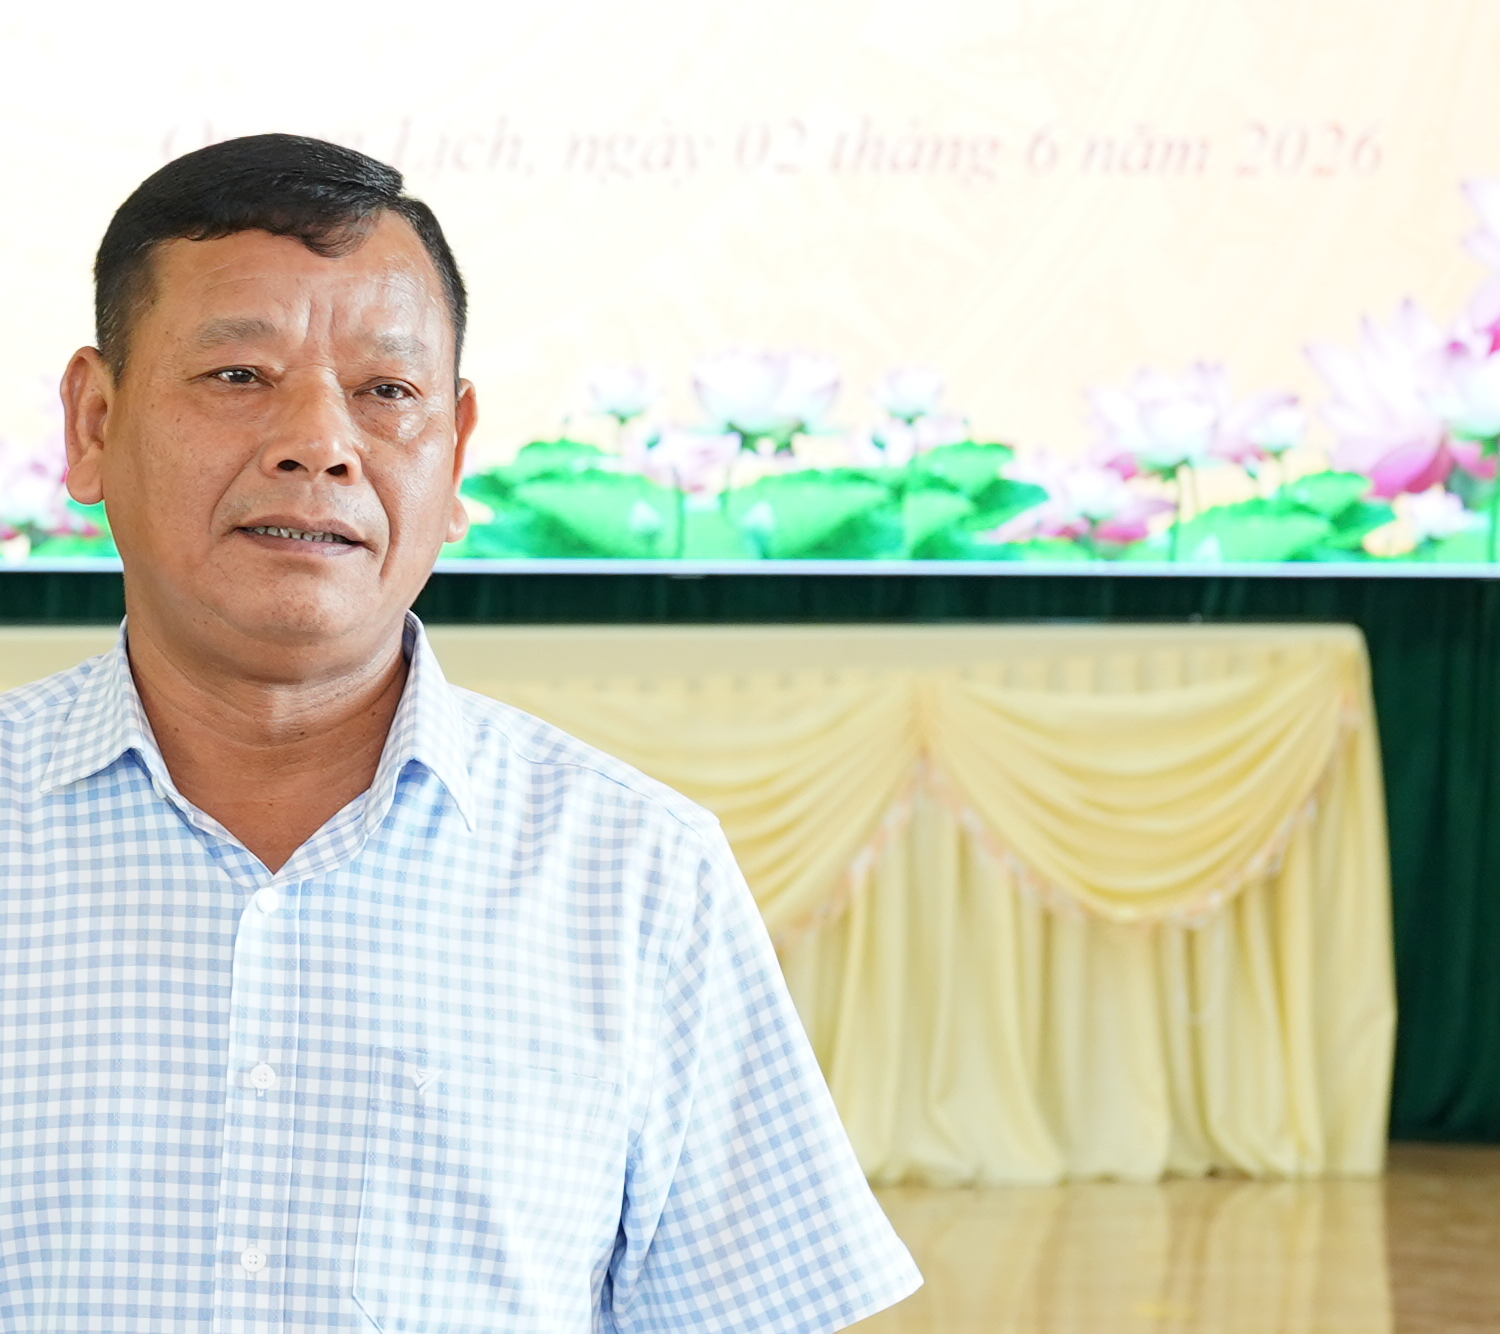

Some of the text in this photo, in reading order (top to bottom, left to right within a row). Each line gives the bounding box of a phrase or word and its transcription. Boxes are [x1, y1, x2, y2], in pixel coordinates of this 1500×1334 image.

[562, 117, 714, 187] ngày
[733, 118, 810, 177] 02
[829, 115, 1001, 187] tháng
[1023, 118, 1063, 177] 6
[1081, 122, 1212, 178] năm
[1234, 119, 1387, 178] 2026
